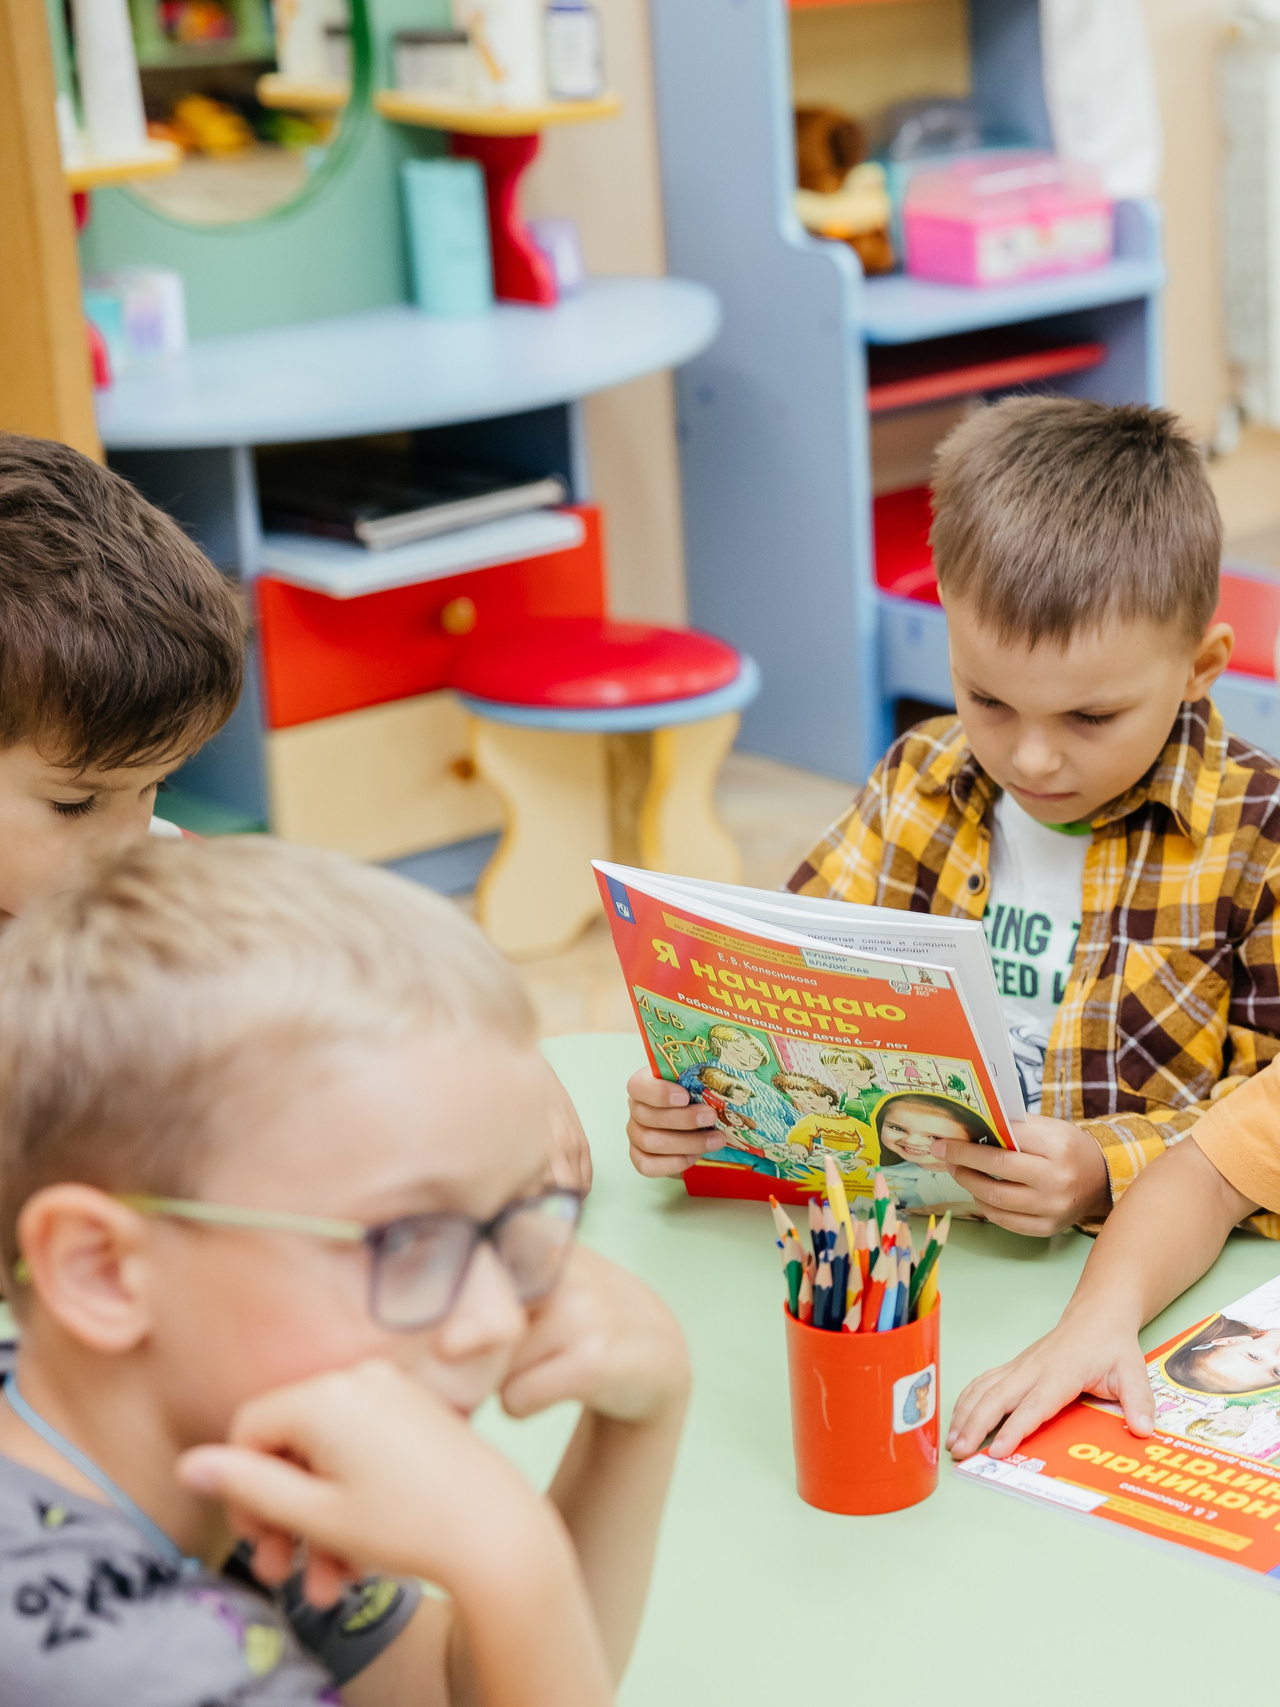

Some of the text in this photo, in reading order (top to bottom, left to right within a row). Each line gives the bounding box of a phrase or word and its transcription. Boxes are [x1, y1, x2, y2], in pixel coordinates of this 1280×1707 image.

[805, 949, 848, 963] КУШНИР
[808, 958, 870, 975] ВЛАДИСЛАВ
[651, 937, 908, 1022] Я начинаю
[717, 952, 818, 986] Е. В. Колесникова
[677, 992, 730, 1017] Рабочая
[732, 1012, 784, 1032] тетрадь
[786, 1026, 810, 1038] для
[813, 1033, 852, 1045] детей
[886, 1041, 909, 1050] лет
[707, 984, 861, 1035] читать
[1172, 1440, 1215, 1457] детей
[1212, 1451, 1240, 1466] для
